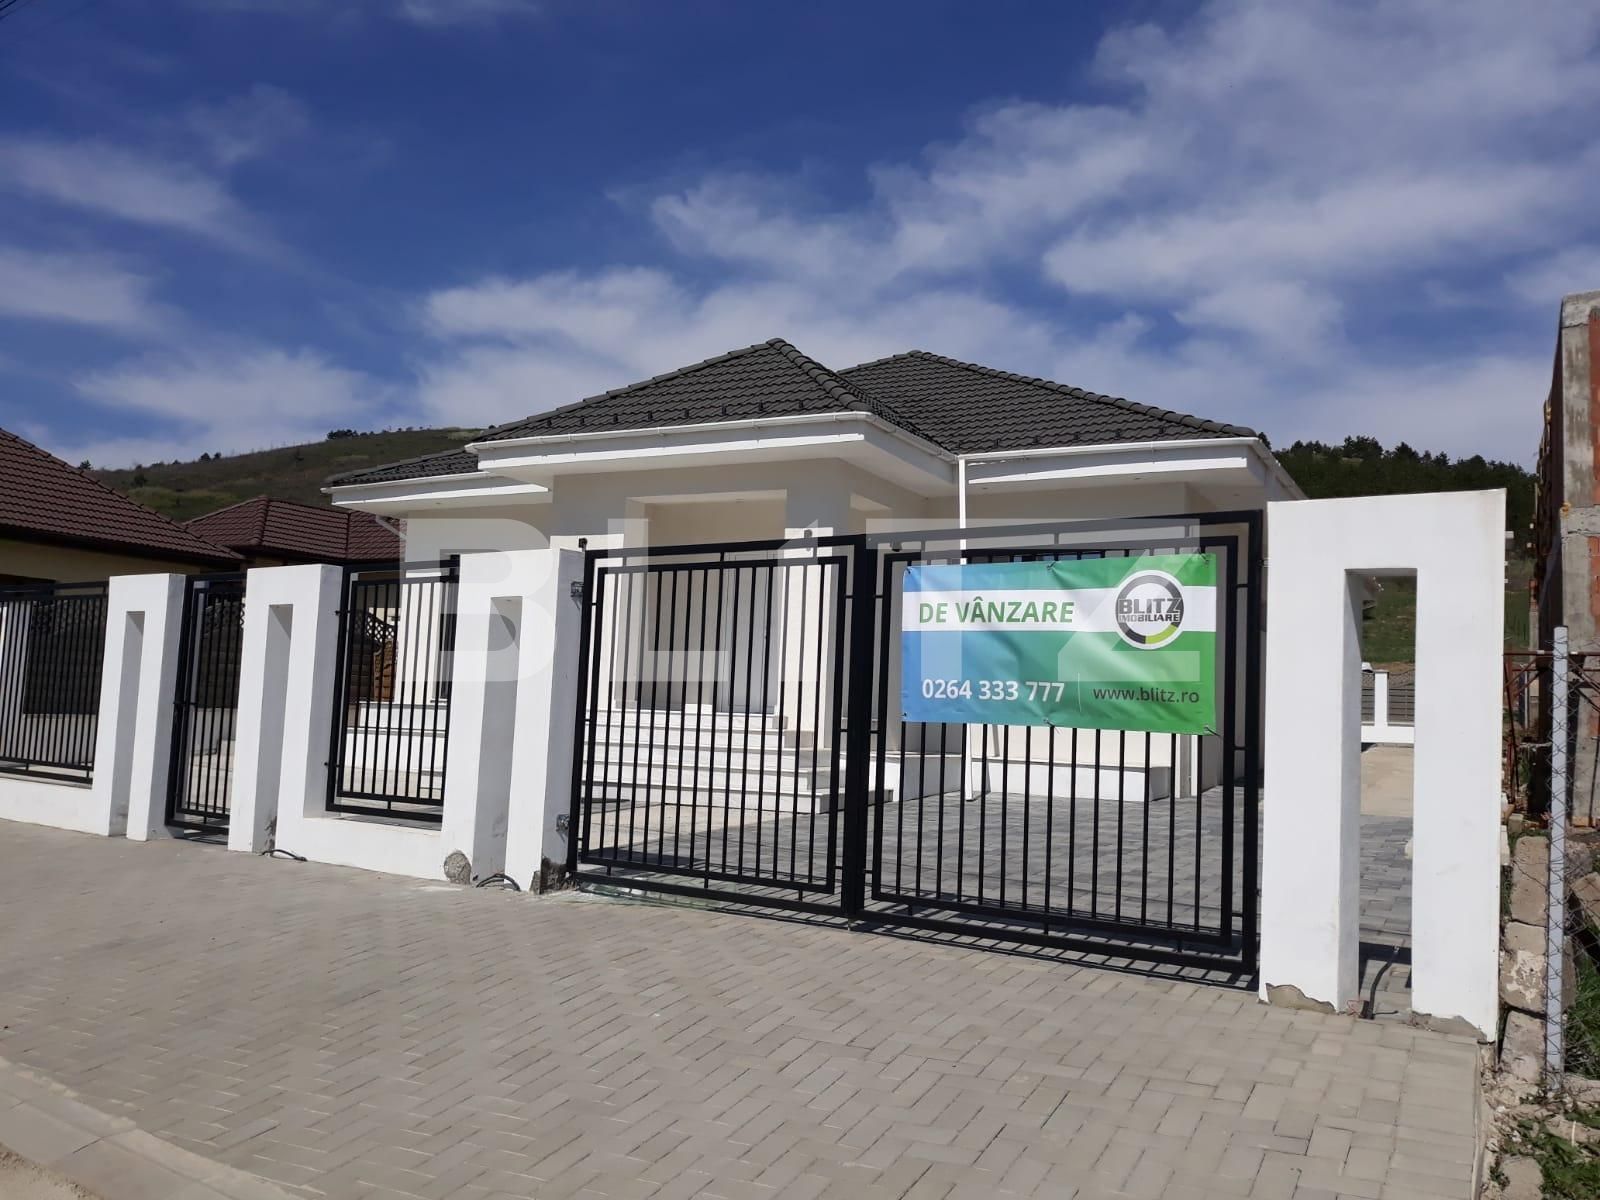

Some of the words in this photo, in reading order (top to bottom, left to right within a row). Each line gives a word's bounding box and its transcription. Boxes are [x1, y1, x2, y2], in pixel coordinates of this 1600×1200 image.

[919, 603, 948, 624] DE
[955, 596, 1075, 624] VÂNZARE
[1119, 598, 1182, 614] BLITZ
[1119, 613, 1180, 622] IMOBILIARE
[921, 679, 973, 700] 0264
[978, 680, 1019, 702] 333
[1025, 682, 1065, 703] 777
[1093, 687, 1200, 704] www.blitz.ro
